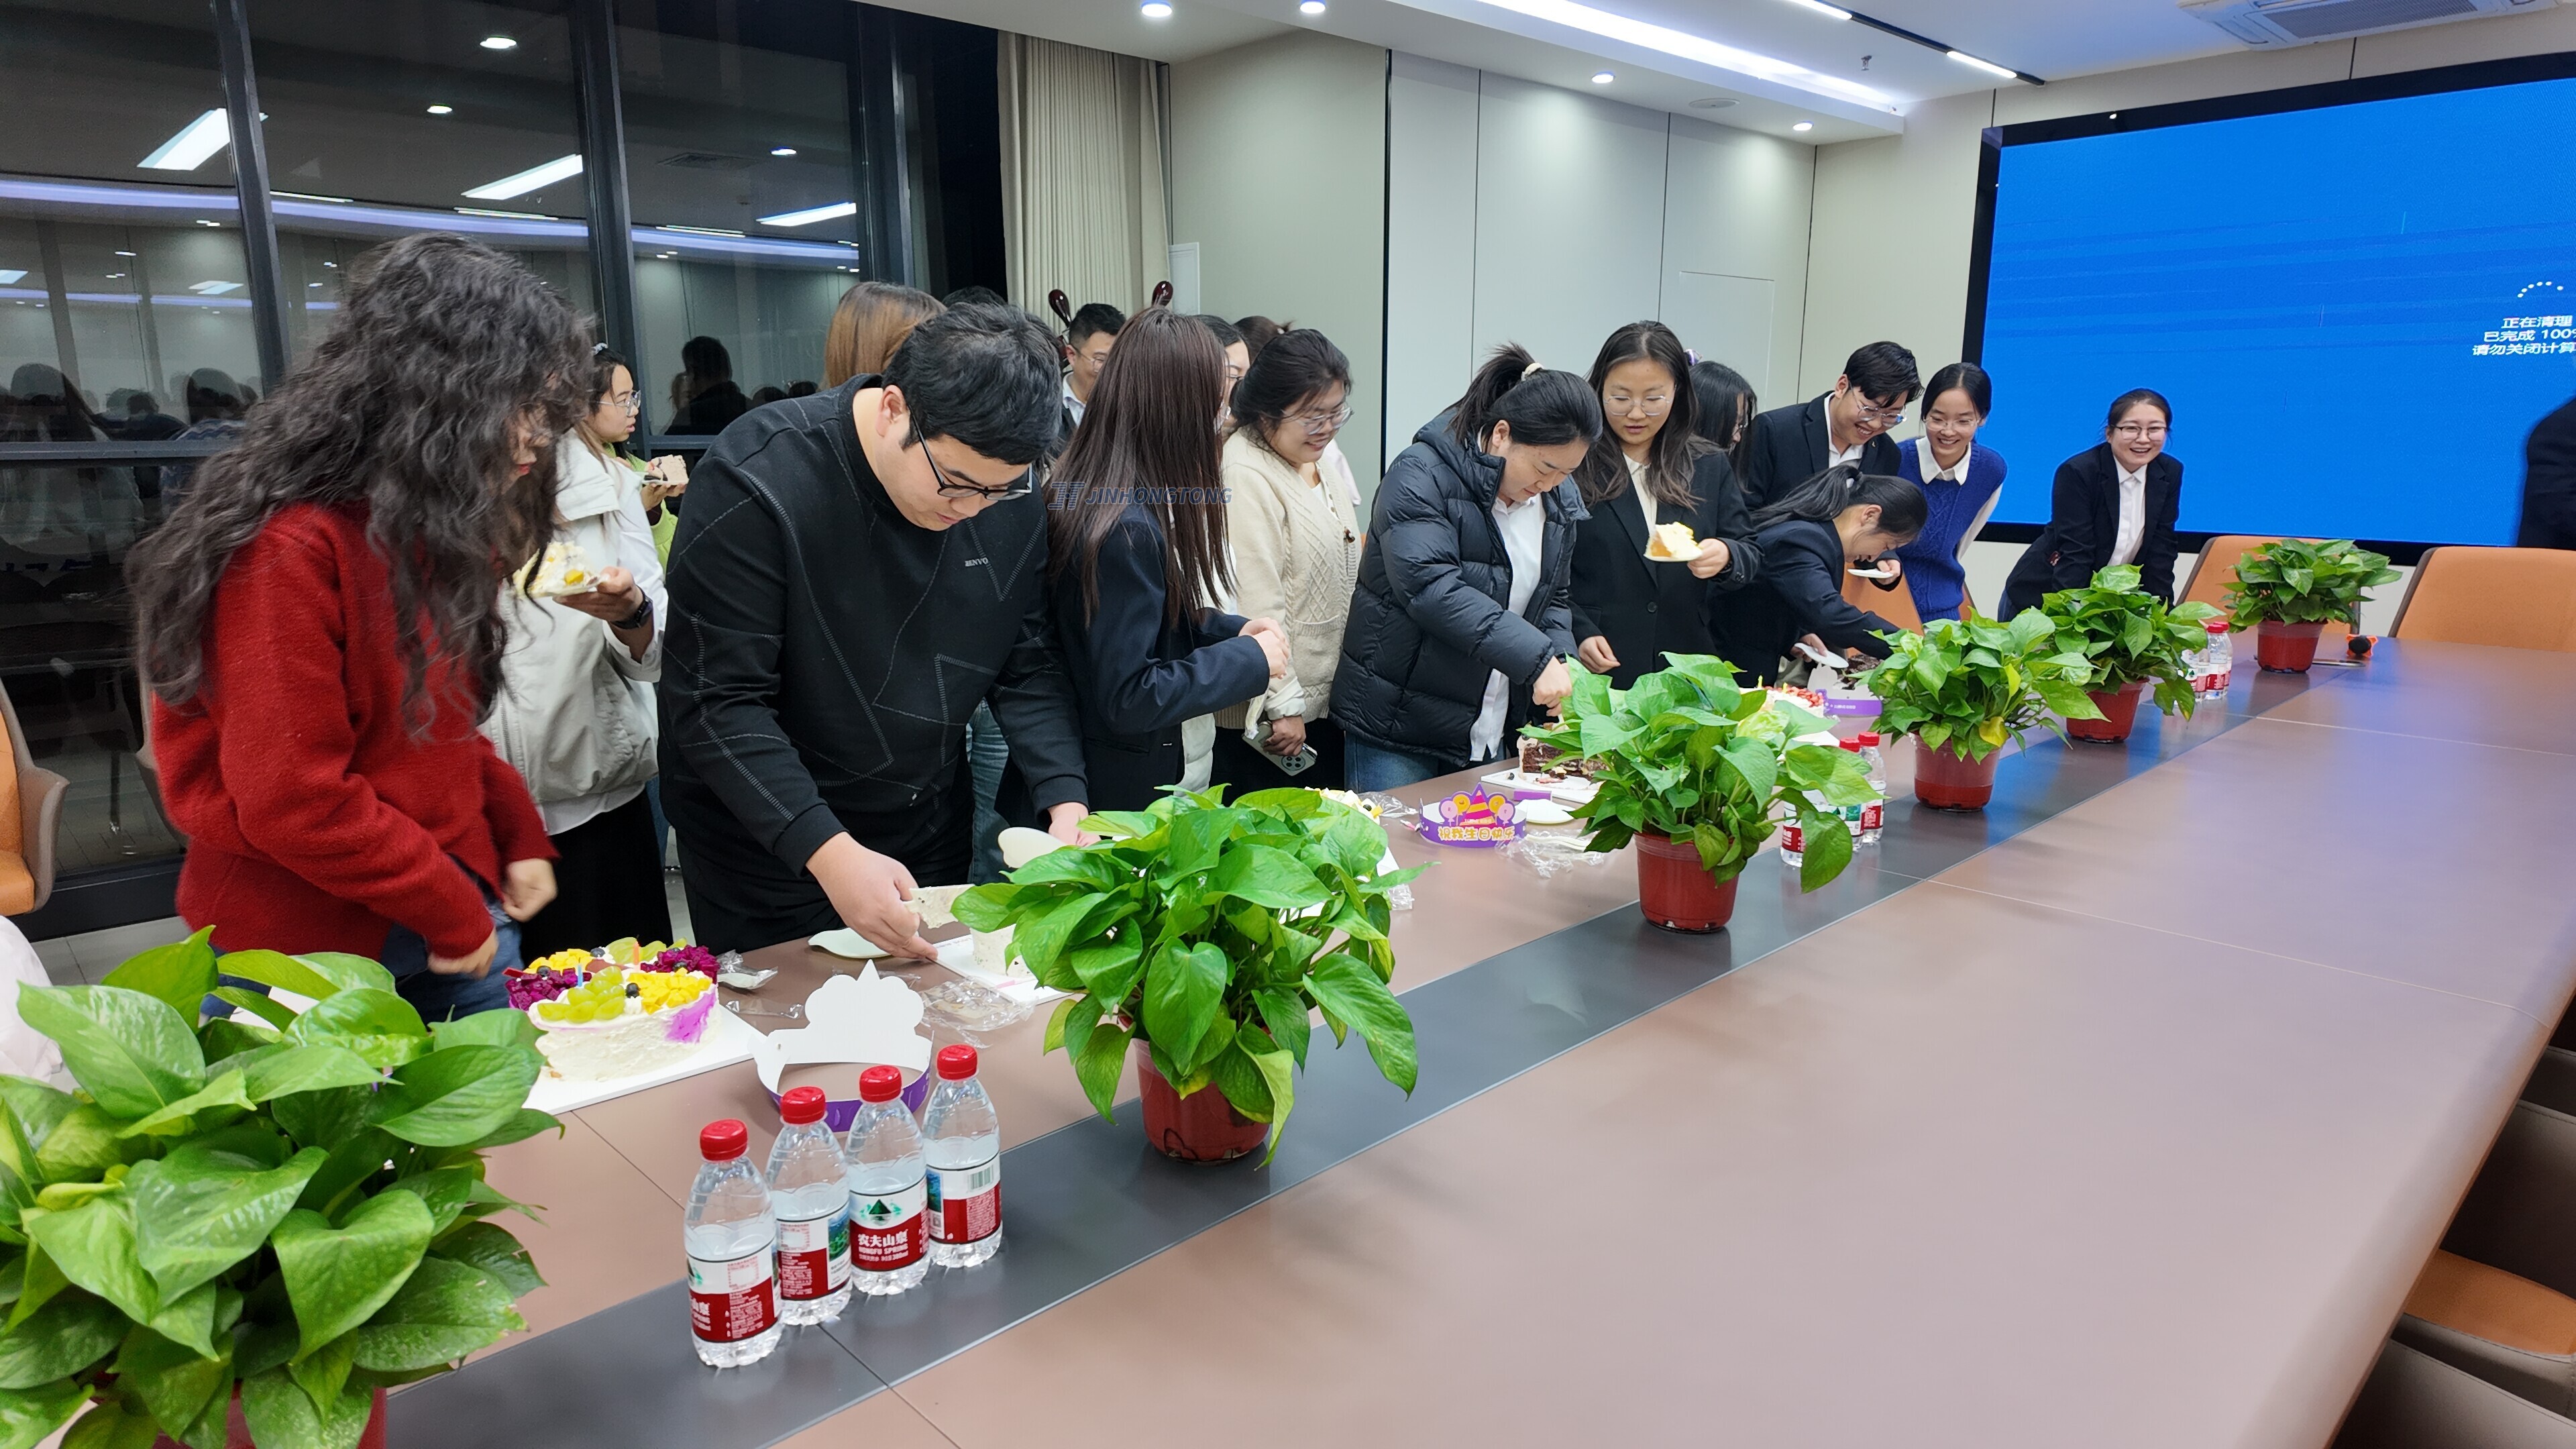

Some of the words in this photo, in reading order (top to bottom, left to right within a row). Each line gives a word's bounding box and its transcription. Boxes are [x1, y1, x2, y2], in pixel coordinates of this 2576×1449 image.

[2501, 315, 2573, 329] 正在清理
[2483, 329, 2536, 342] 已完成
[2472, 341, 2576, 356] 请勿关闭计算
[1438, 826, 1515, 841] 祝我生日快乐
[858, 1229, 908, 1247] 农夫山泉
